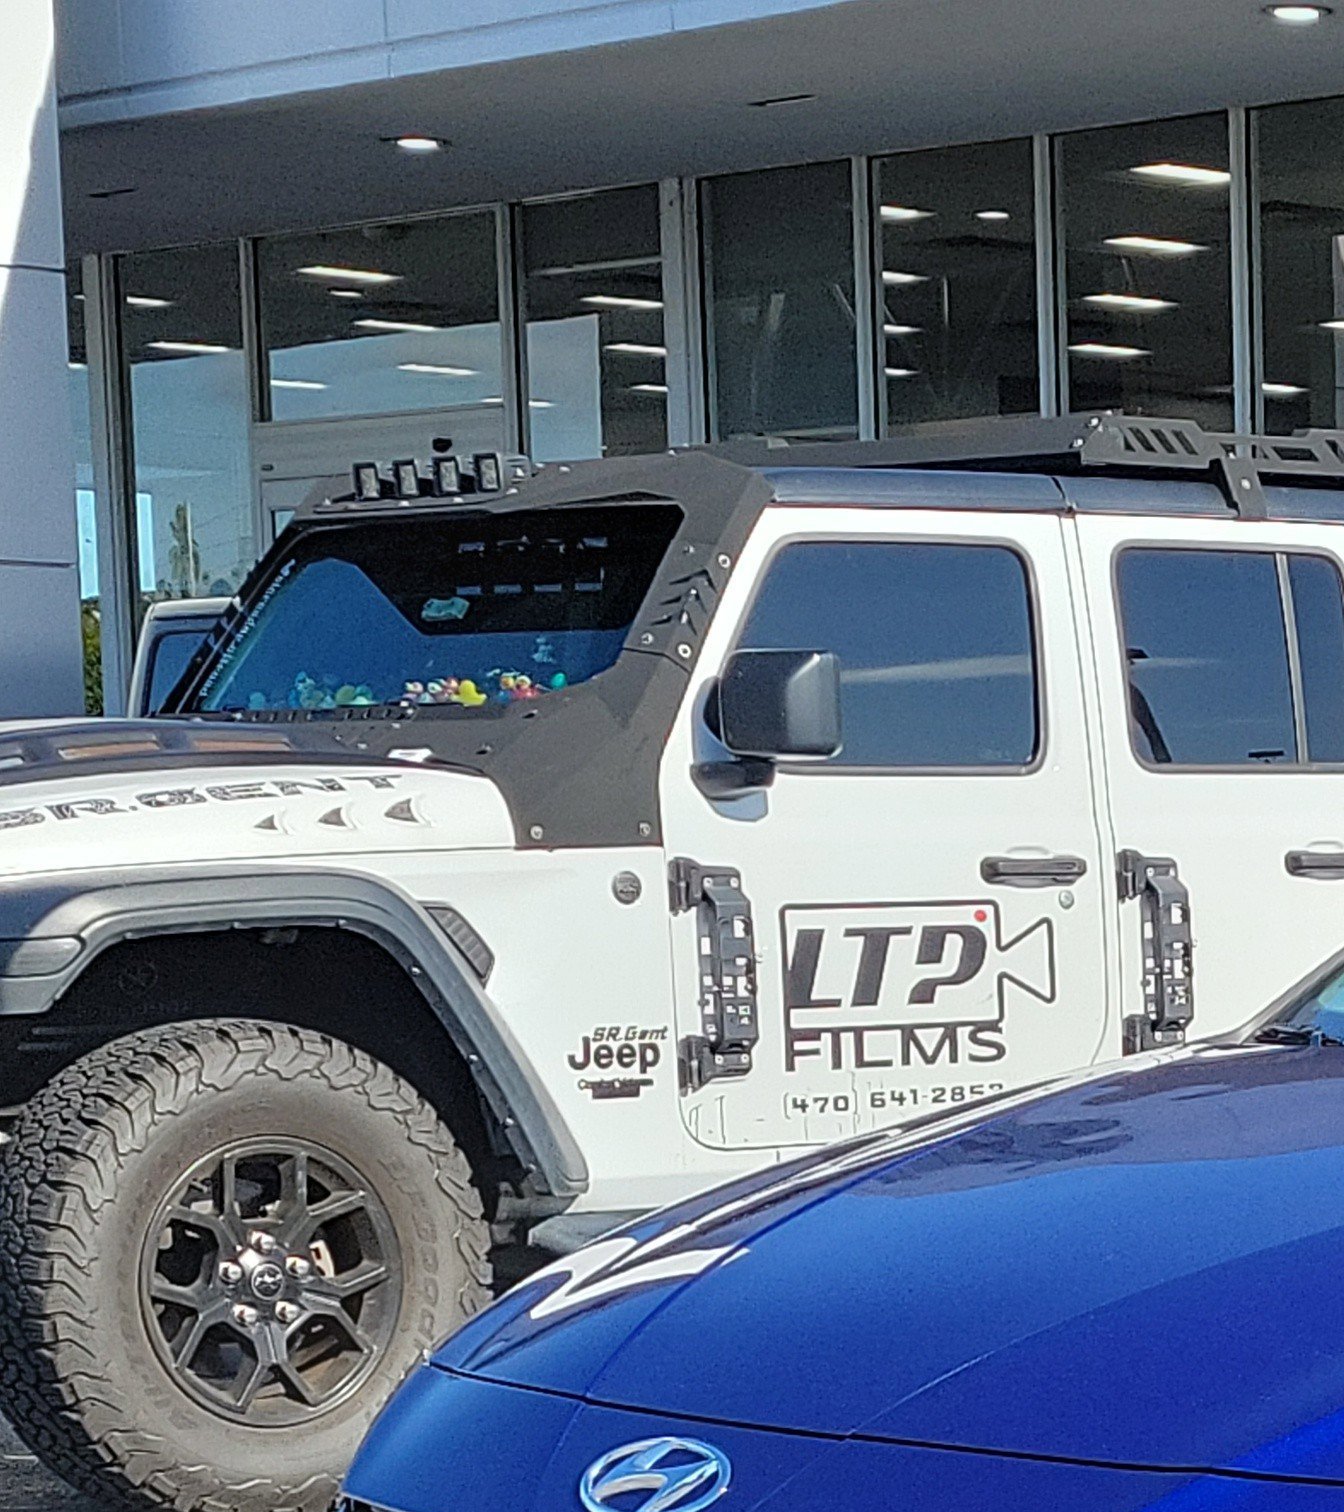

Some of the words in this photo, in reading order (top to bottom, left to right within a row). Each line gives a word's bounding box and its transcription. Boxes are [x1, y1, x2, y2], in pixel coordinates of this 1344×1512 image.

[788, 924, 987, 1008] LTP
[567, 1035, 661, 1074] Jeep
[785, 1024, 1007, 1072] FILMS
[784, 1091, 858, 1120] (470)
